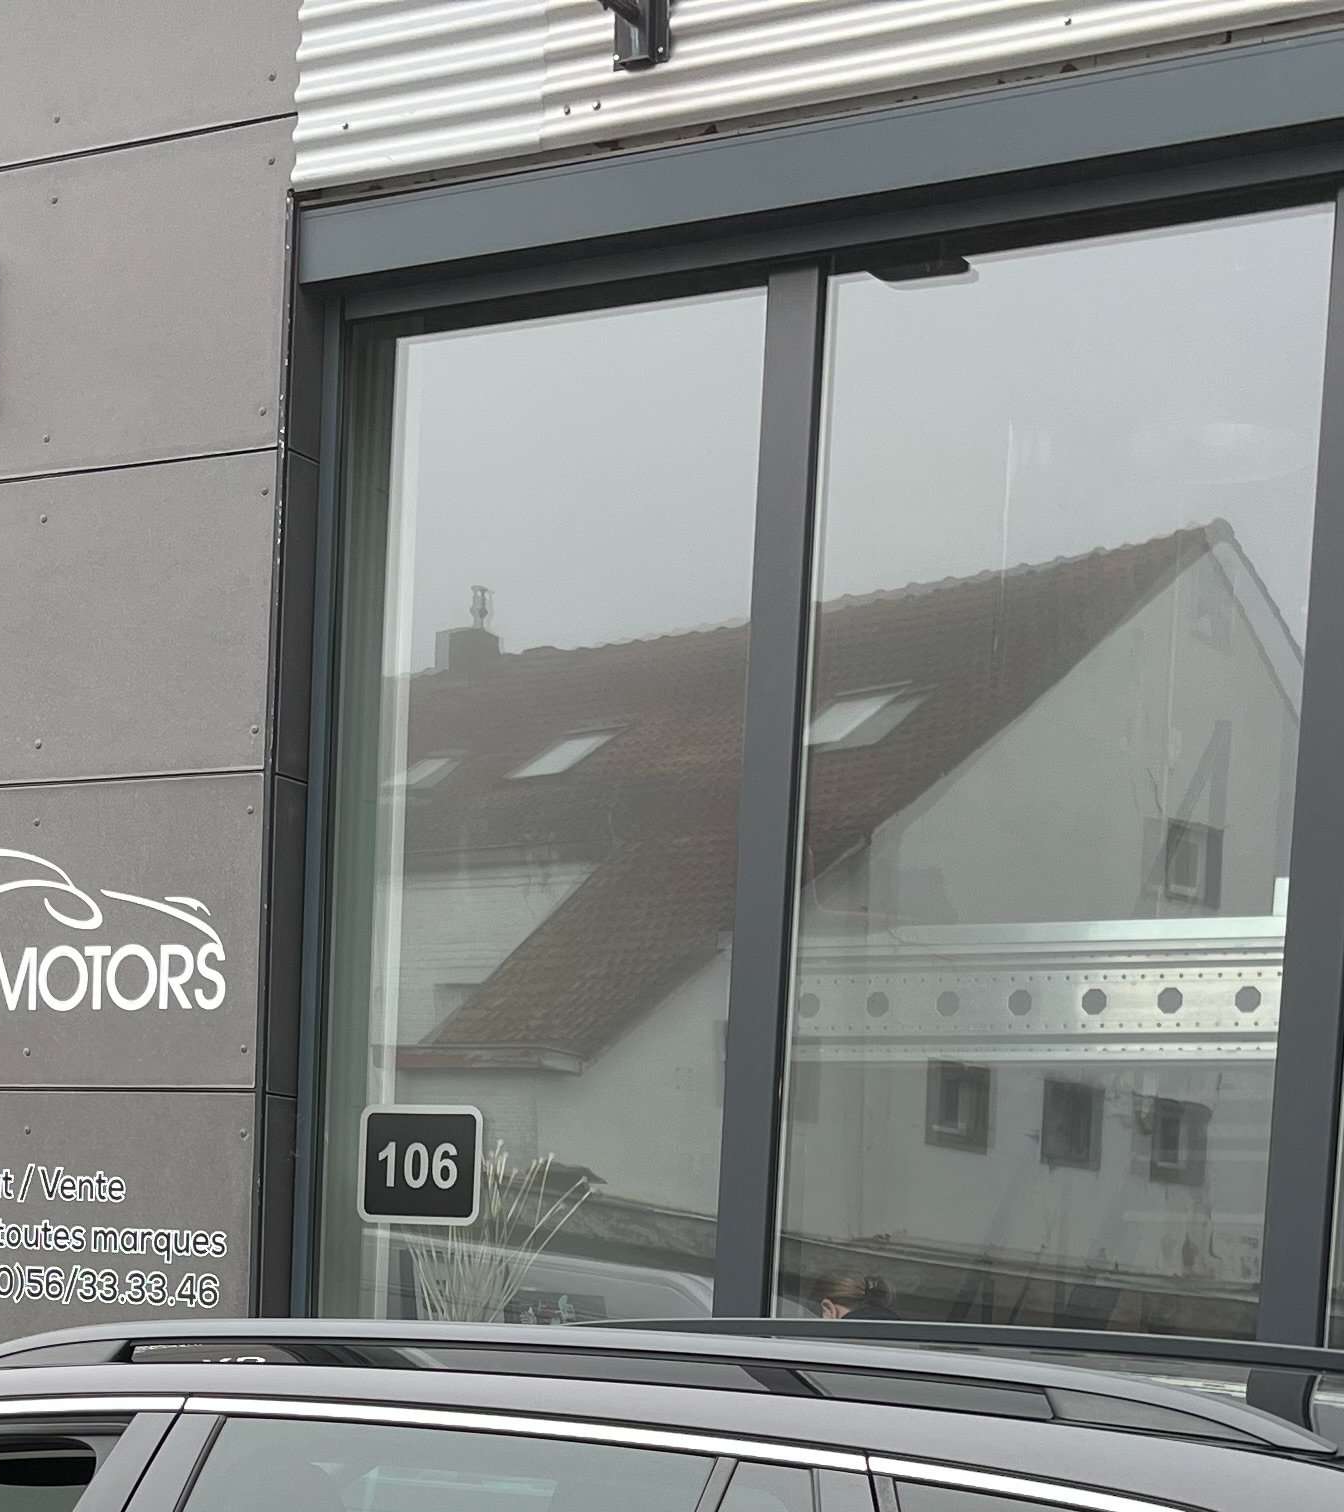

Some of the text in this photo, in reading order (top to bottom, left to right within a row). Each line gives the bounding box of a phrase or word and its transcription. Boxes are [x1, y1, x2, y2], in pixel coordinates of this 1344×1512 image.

[17, 1164, 35, 1203] /
[38, 1166, 127, 1202] Vente
[376, 1142, 459, 1190] 106
[91, 1228, 227, 1264] marques
